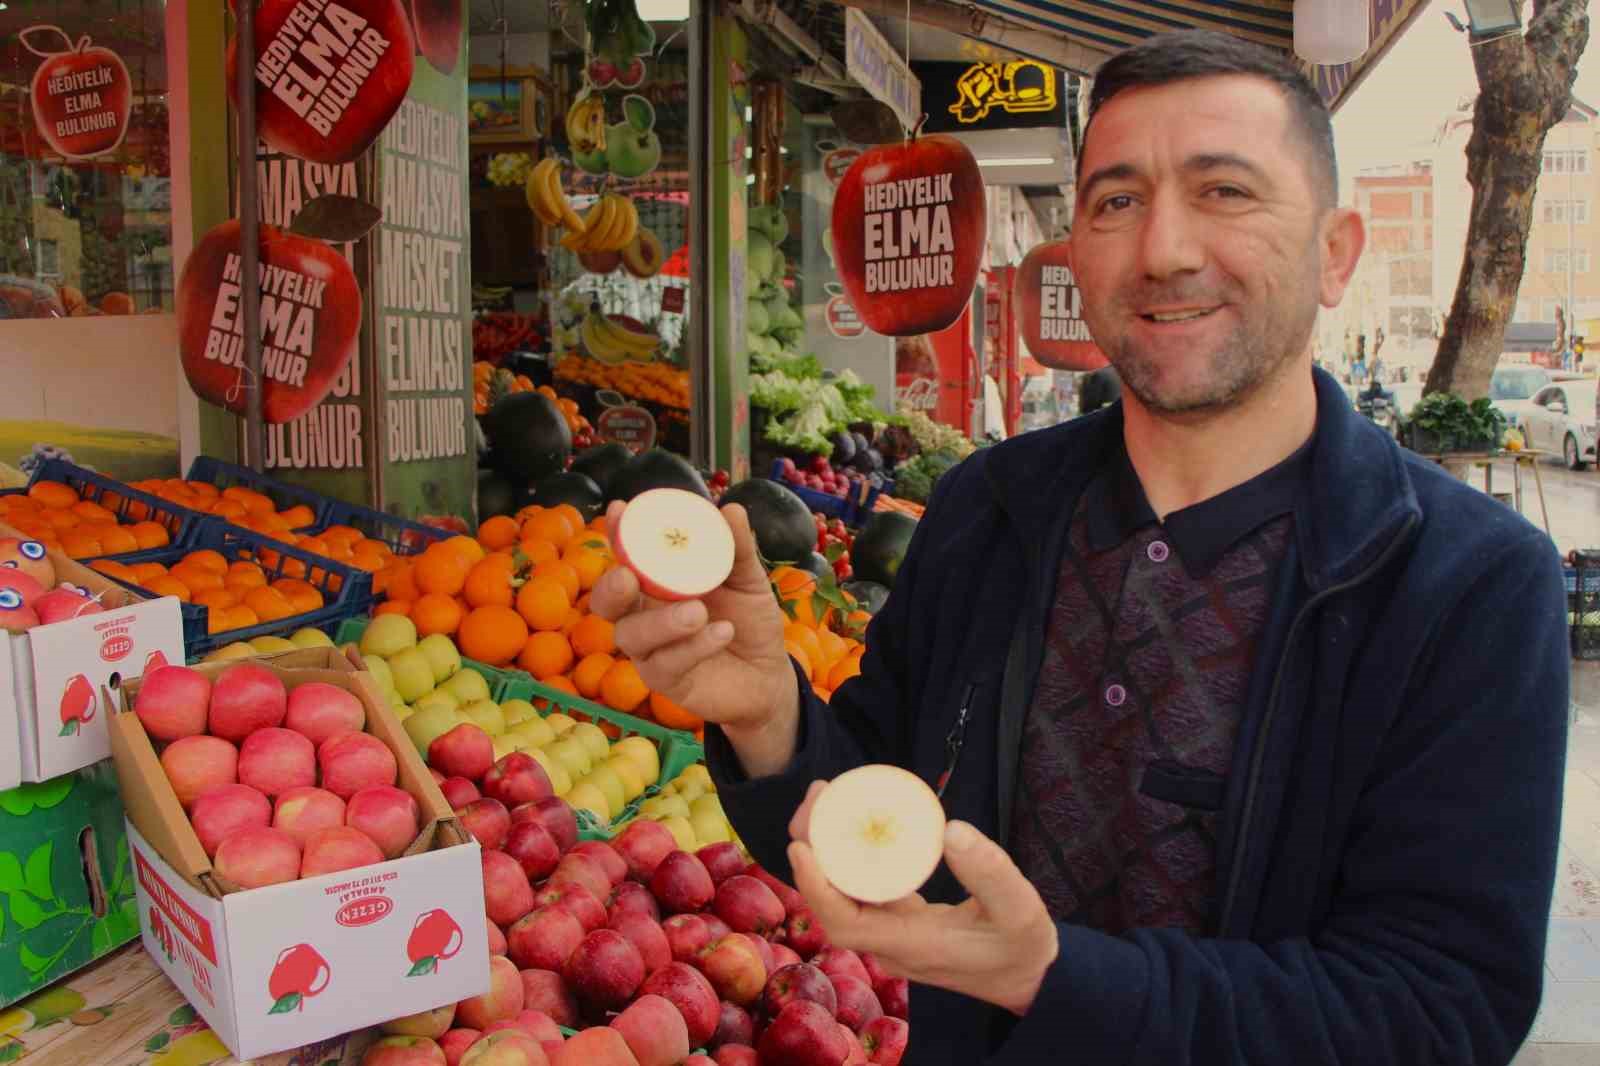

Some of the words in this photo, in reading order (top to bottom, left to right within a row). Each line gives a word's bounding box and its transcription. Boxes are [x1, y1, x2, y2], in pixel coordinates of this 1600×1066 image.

[255, 0, 329, 88] HEDİYELİ
[272, 2, 368, 118] ELMA
[64, 92, 102, 114] ELMA
[306, 27, 390, 137] BULUNUR
[56, 112, 117, 137] BULUNUR
[236, 157, 358, 229] MASYA
[383, 154, 462, 239] AMASYA
[864, 204, 955, 260] ELMA
[223, 252, 327, 309] HİYELİK
[864, 254, 954, 293] BULUNUR
[1041, 265, 1075, 286] HED
[204, 329, 308, 388] BULNUR
[384, 315, 465, 392] ELMASI
[243, 404, 363, 470] ULUNUR
[387, 397, 467, 463] BULUNUR
[341, 901, 388, 921] GEZEN
